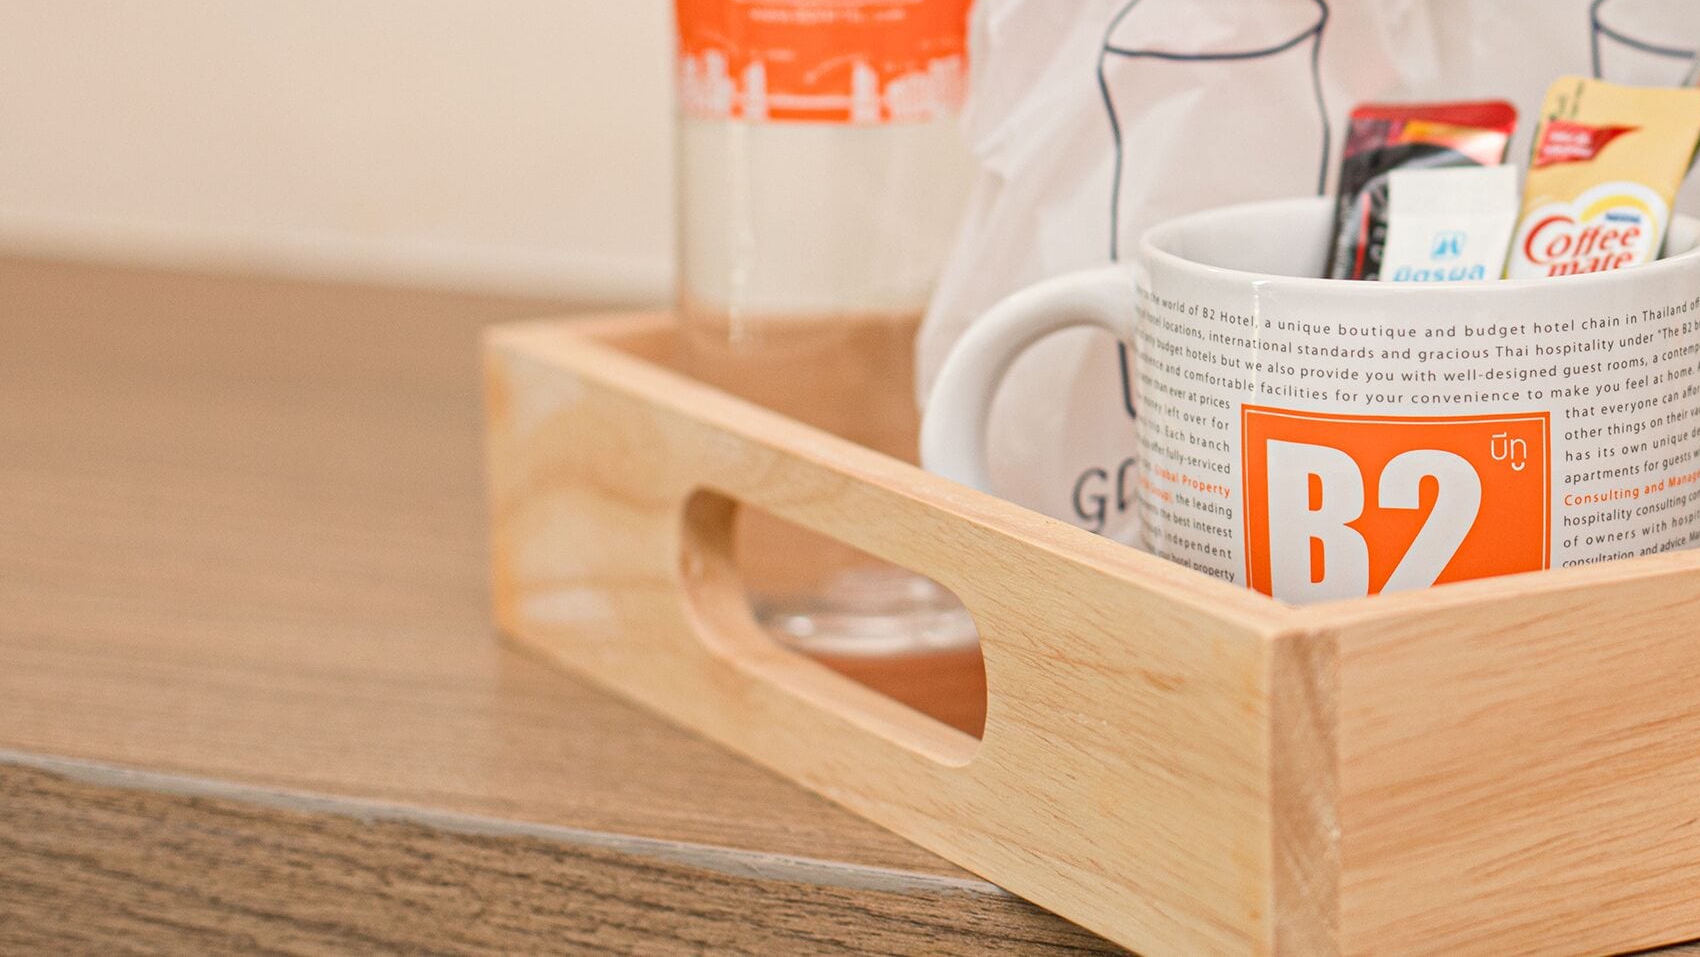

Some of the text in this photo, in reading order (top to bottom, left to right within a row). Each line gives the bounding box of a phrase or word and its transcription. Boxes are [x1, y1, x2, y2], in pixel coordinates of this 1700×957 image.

[1524, 213, 1641, 265] Coffee
[1162, 298, 1186, 314] world
[1188, 304, 1199, 316] of
[1202, 307, 1215, 321] B2
[1220, 310, 1258, 329] Hotel,
[1265, 319, 1271, 329] a
[1278, 320, 1331, 335] unique
[1338, 323, 1417, 340] boutique
[1425, 325, 1456, 338] and
[1464, 323, 1526, 339] budget
[1533, 319, 1575, 334] hotel
[1581, 316, 1620, 331] chain
[1625, 313, 1637, 325] in
[1642, 300, 1688, 322] Thailand
[1162, 315, 1205, 340] locations,
[1209, 329, 1292, 354] international
[1297, 344, 1375, 359] standards
[1381, 347, 1411, 360] and
[1418, 347, 1489, 362] gracious
[1495, 345, 1529, 358] Thai
[1535, 338, 1615, 357] hospitality
[1619, 332, 1653, 348] under
[1682, 321, 1692, 335] B2
[1186, 345, 1217, 365] hotels
[1221, 353, 1241, 369] but
[1245, 360, 1262, 372] we
[1267, 361, 1295, 376] also
[1300, 366, 1359, 380] provide
[1365, 371, 1394, 384] you
[1401, 369, 1437, 382] with
[1444, 364, 1558, 382] well-designed
[1563, 361, 1602, 378] guest
[1607, 356, 1648, 371] rooms,
[1652, 354, 1658, 364] a
[1165, 363, 1181, 377] and
[1184, 368, 1255, 392] comfortable
[1260, 381, 1328, 401] facilities
[1335, 389, 1358, 402] for
[1365, 393, 1403, 405] your
[1411, 388, 1520, 404] convenience
[1528, 389, 1543, 400] to
[1551, 385, 1590, 399] make
[1596, 382, 1620, 398] you
[1625, 375, 1649, 390] feel
[1653, 374, 1663, 385] at
[1667, 366, 1695, 382] home.
[1169, 386, 1231, 410] ever at prices
[1165, 404, 1229, 431] left over for
[1565, 405, 1595, 419] that
[1601, 396, 1658, 415] everyone
[1662, 392, 1679, 404] can
[1165, 425, 1186, 442] Each
[1189, 433, 1230, 452] branch
[1565, 428, 1602, 441] other
[1607, 420, 1646, 435] things
[1650, 417, 1663, 429] on
[1666, 410, 1688, 425] their
[1166, 446, 1231, 475] fully-serviced
[1565, 431, 1688, 462] has its own unique
[1564, 463, 1639, 485] apartments
[1644, 459, 1659, 472] for
[1662, 452, 1692, 470] guests
[1182, 473, 1231, 499] Property
[1564, 486, 1640, 506] Consulting
[1644, 479, 1664, 495] and
[1176, 492, 1190, 507] the
[1192, 497, 1233, 520] leading
[1563, 494, 1687, 527] hospitality consulting
[1173, 512, 1233, 539] best interest
[1266, 438, 1482, 606] B2
[1563, 535, 1579, 549] of
[1585, 529, 1636, 546] owners
[1641, 521, 1667, 536] with
[1164, 531, 1233, 560] independent
[1640, 543, 1658, 557] and
